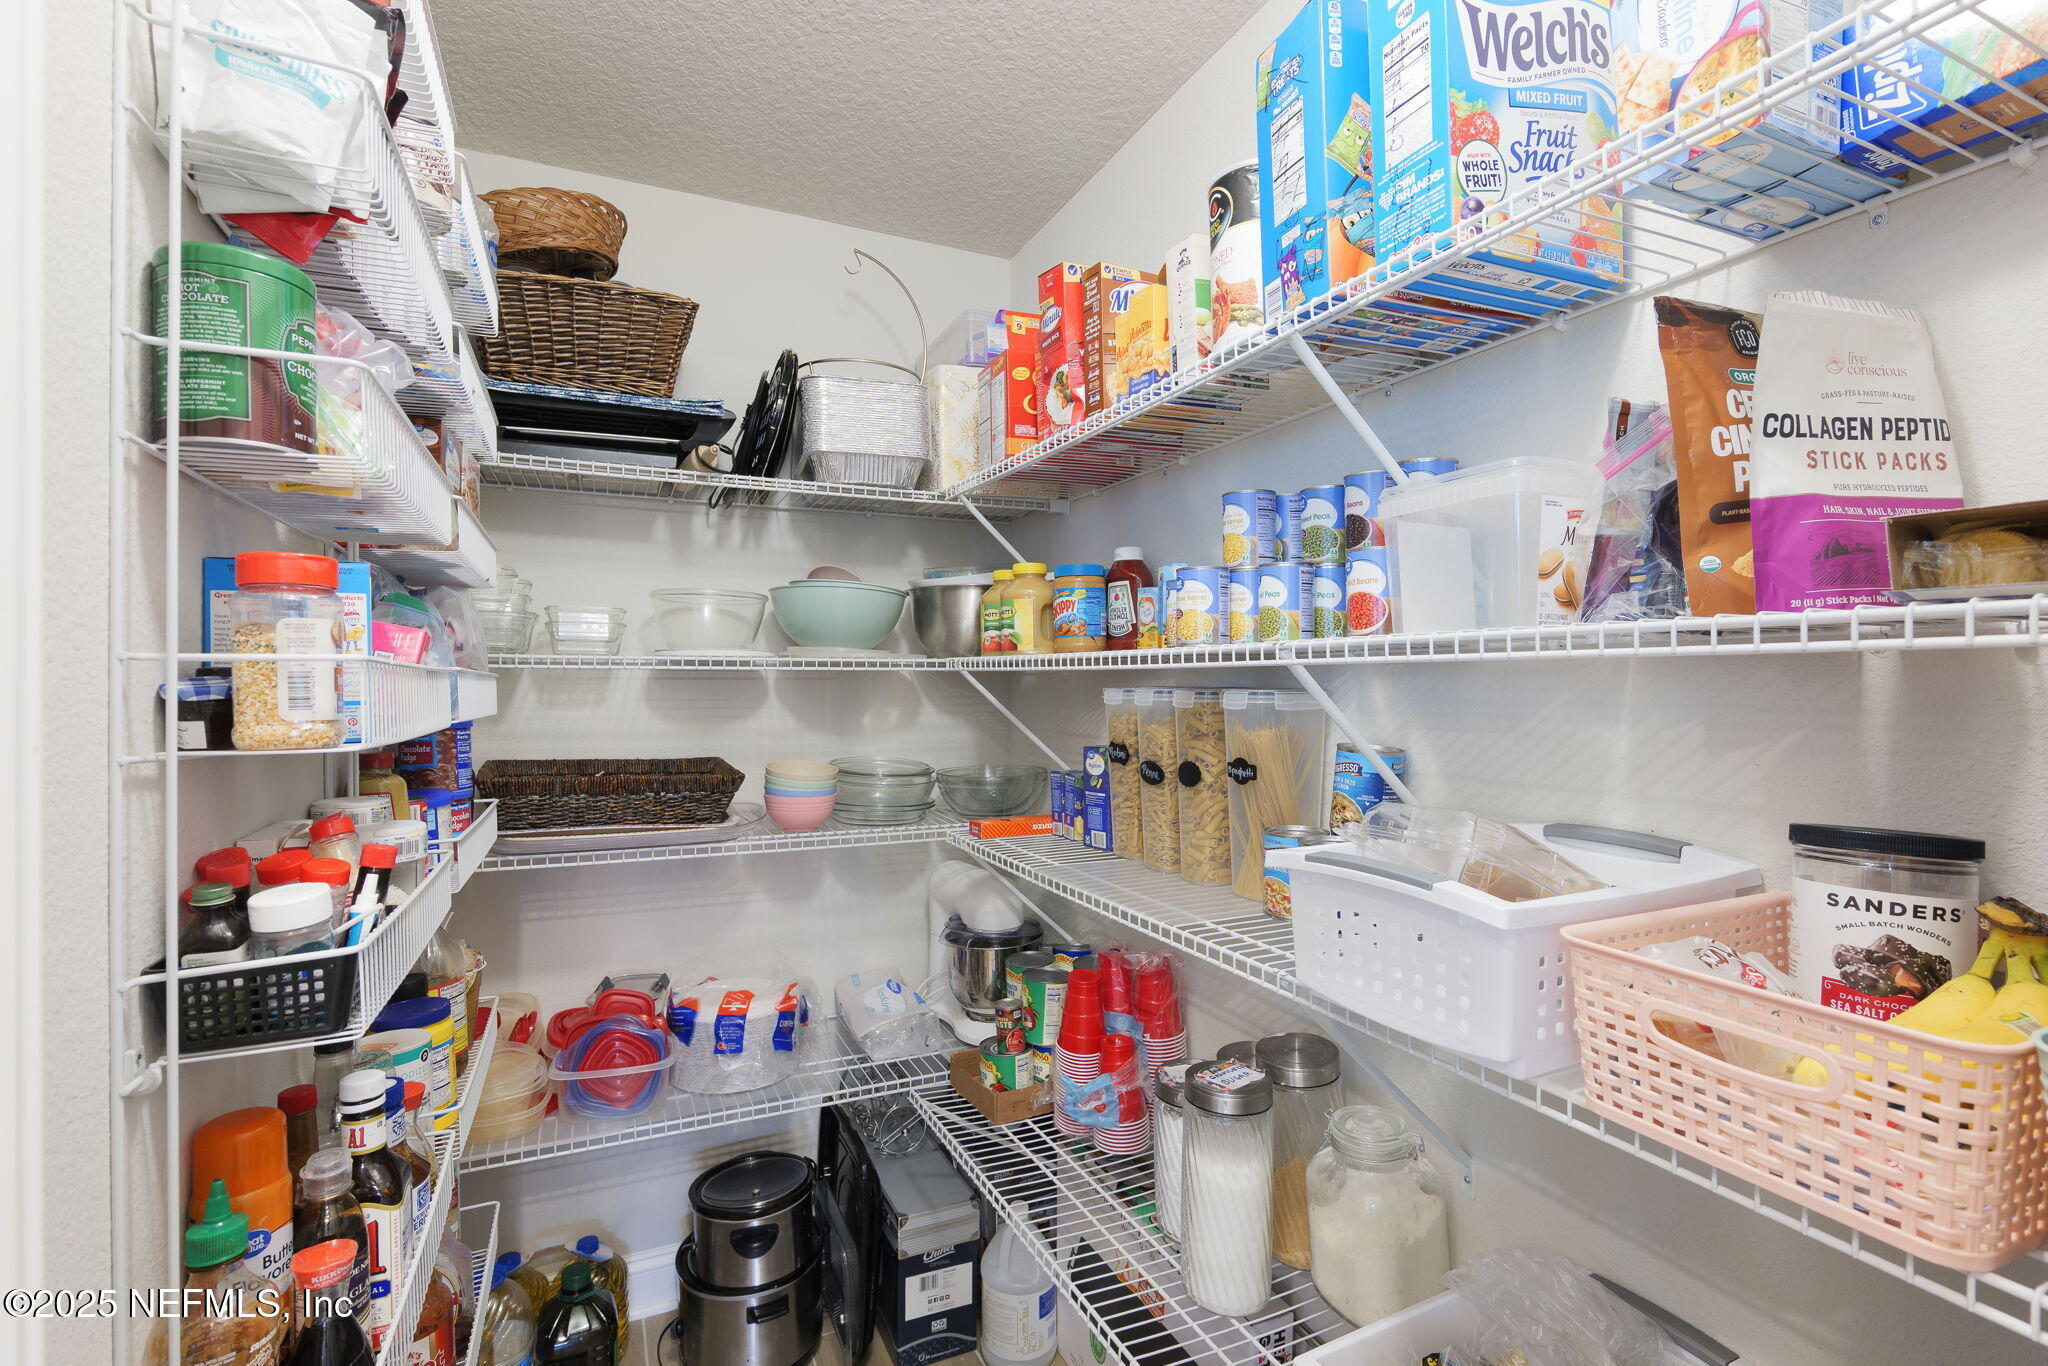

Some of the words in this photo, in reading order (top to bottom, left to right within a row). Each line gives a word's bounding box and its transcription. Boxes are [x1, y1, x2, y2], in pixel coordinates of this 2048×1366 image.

[1656, 0, 1671, 48] Crackers
[1462, 0, 1610, 71] Welch's
[1507, 74, 1533, 84] FAMILY
[1534, 69, 1562, 81] FARMER
[1563, 66, 1586, 76] OWNED
[1516, 89, 1551, 104] MIXED
[1553, 92, 1583, 107] FRUIT
[1523, 120, 1579, 149] Fruit
[1462, 159, 1500, 172] WHOLE
[1395, 167, 1446, 205] BRANDS!
[1465, 173, 1502, 189] FRUIT!
[160, 292, 229, 304] CCOLATE
[1015, 322, 1022, 331] 9
[1847, 351, 1868, 366] live
[1847, 363, 1908, 377] conscious
[1820, 389, 1856, 400] GRASS-FED
[1862, 390, 1916, 402] PASTURE-RAISED
[1762, 413, 1874, 441] COLLAGEN
[1881, 417, 1952, 442] PEPTID
[1806, 449, 1868, 471] STICK
[1876, 451, 1948, 472] PACKS
[1832, 483, 1852, 492] PURE
[1852, 483, 1897, 493] HYDROLYZED
[1897, 484, 1929, 494] PEPTIDES
[1346, 499, 1364, 509] Beans
[1823, 504, 1845, 514] HAIR,
[1845, 506, 1866, 516] SKIN,
[1866, 506, 1888, 516] NAIL
[1888, 507, 1894, 516] &
[1313, 512, 1331, 521] Peas
[1356, 576, 1379, 586] Beans
[1264, 590, 1280, 598] Peas
[1316, 591, 1335, 599] Peas
[1790, 598, 1803, 608] 20
[1815, 597, 1825, 608] g)
[1826, 595, 1848, 606] Stick
[1849, 594, 1873, 604] Packs
[1876, 595, 1889, 603] Net
[1111, 624, 1126, 632] HEINZ
[1227, 764, 1255, 780] Spaghetti
[1336, 762, 1359, 773] RESSO
[1031, 822, 1053, 830] anza
[1826, 892, 1963, 923] SANDERS
[1835, 920, 1867, 932] SMALL
[1868, 920, 1904, 930] BATCH
[1906, 924, 1953, 948] WONDERS
[1839, 991, 1871, 1005] DARK
[1830, 998, 1851, 1014] SEA
[1855, 1004, 1886, 1020] SALT
[999, 1021, 1015, 1029] STE
[1221, 1071, 1253, 1086] SUGAR
[310, 1262, 354, 1284] KIKKOM
